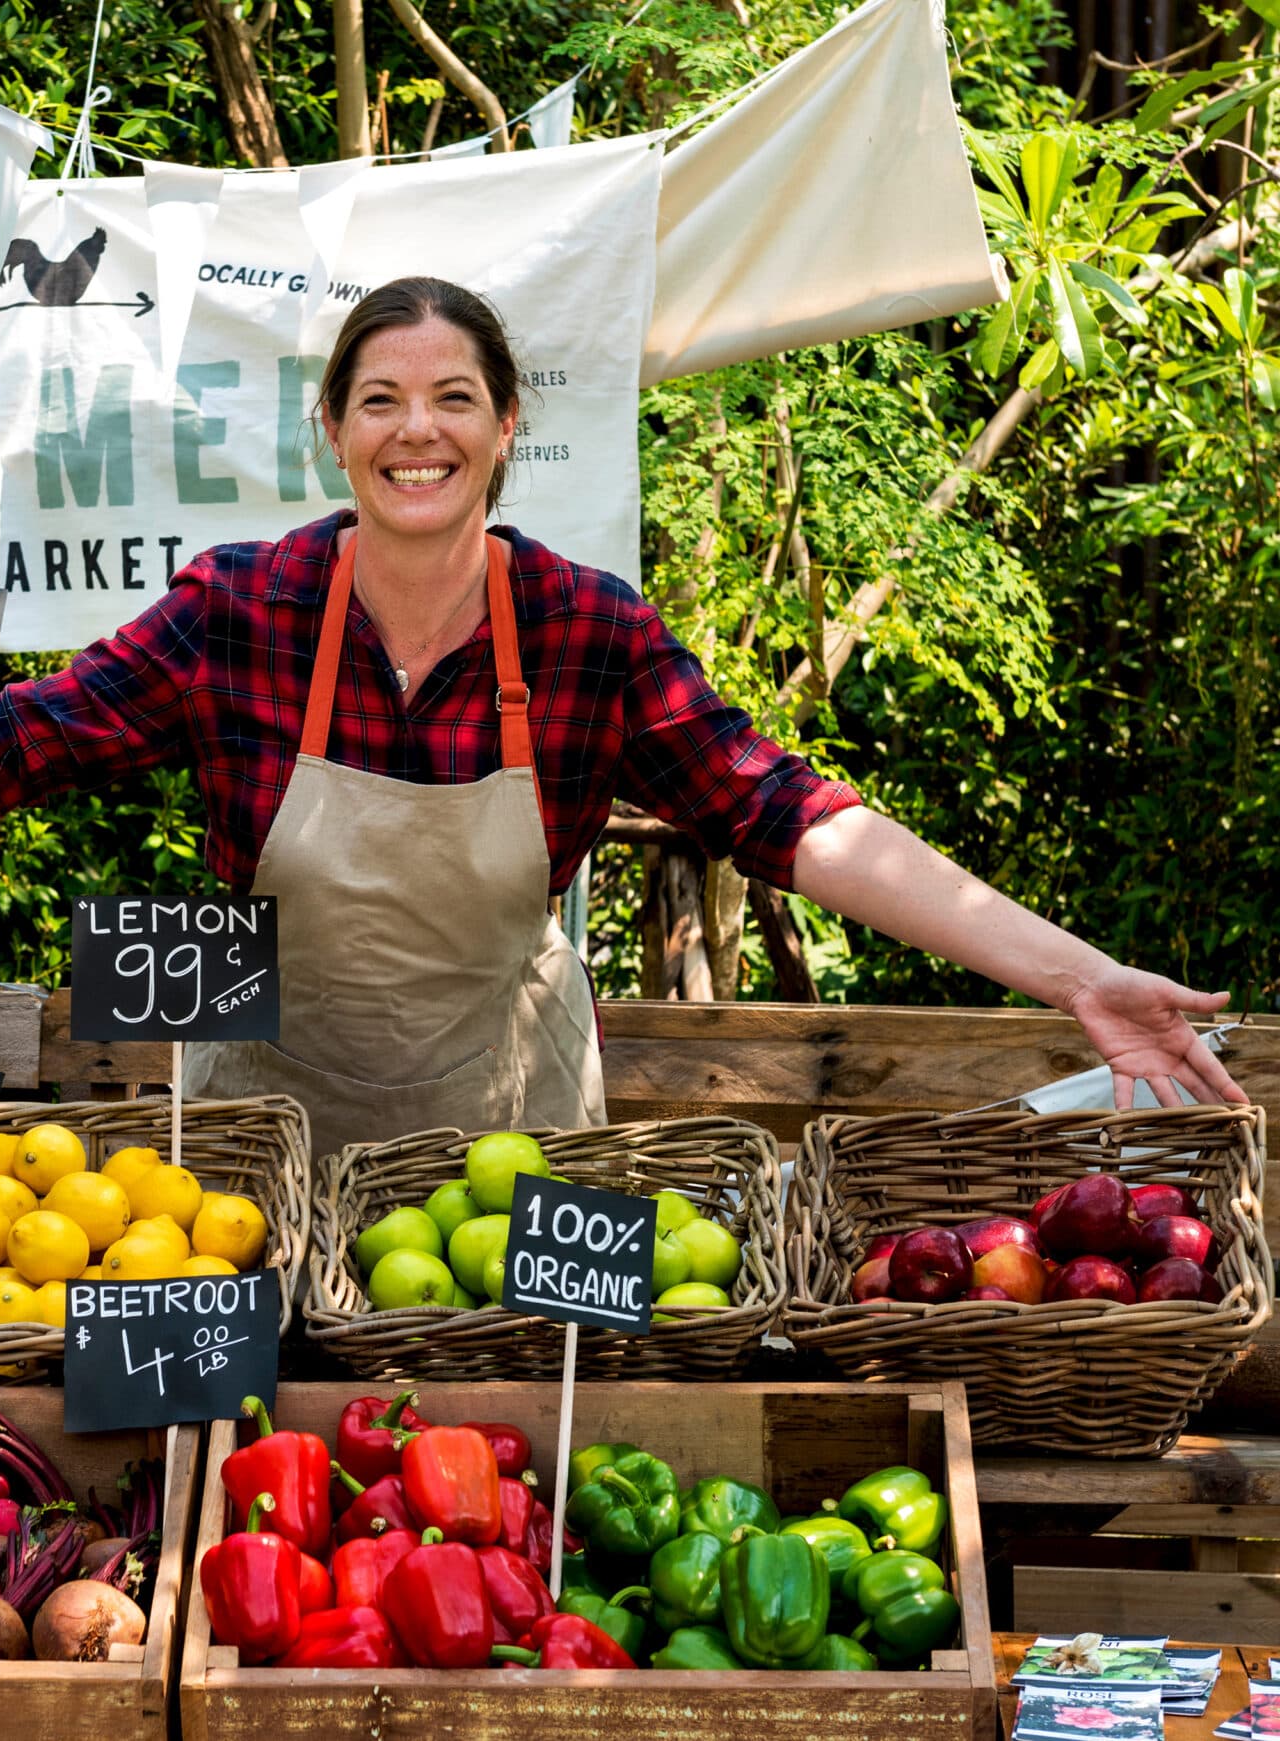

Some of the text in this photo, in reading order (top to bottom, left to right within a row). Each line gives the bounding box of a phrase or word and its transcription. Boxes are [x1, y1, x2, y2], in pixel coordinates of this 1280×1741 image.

[198, 263, 372, 303] OCALLY GWN
[520, 370, 567, 387] ABLES
[515, 444, 570, 462] SERVES
[216, 982, 261, 1015] EACH
[525, 1194, 646, 1256] 100%
[70, 1275, 262, 1319] BEETROOT
[514, 1250, 644, 1312] ORGANIC
[198, 1351, 229, 1378] LB
